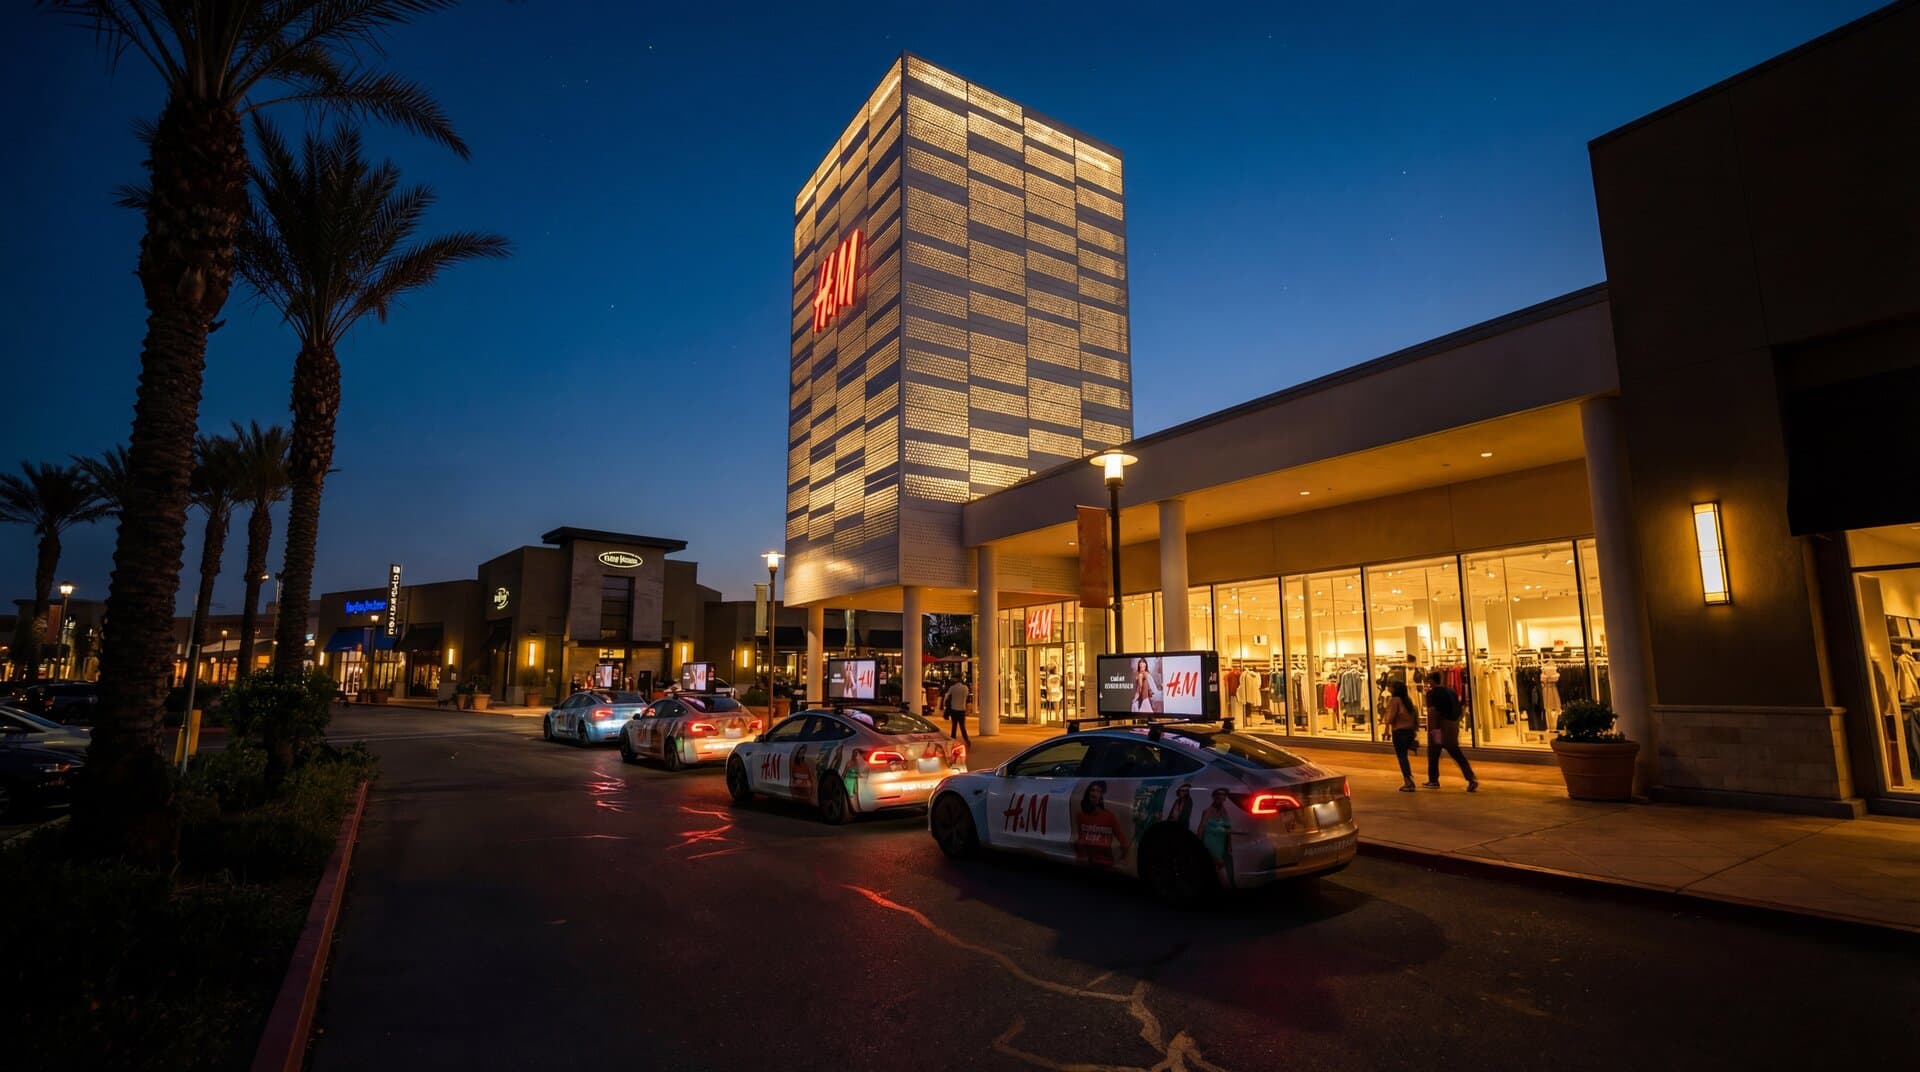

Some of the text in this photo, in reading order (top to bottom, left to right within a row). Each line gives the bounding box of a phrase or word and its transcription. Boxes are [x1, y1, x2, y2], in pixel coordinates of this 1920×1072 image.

[813, 228, 860, 333] H&M
[1027, 610, 1054, 643] H&M
[1166, 671, 1199, 698] H&M
[1003, 792, 1049, 835] H&M
